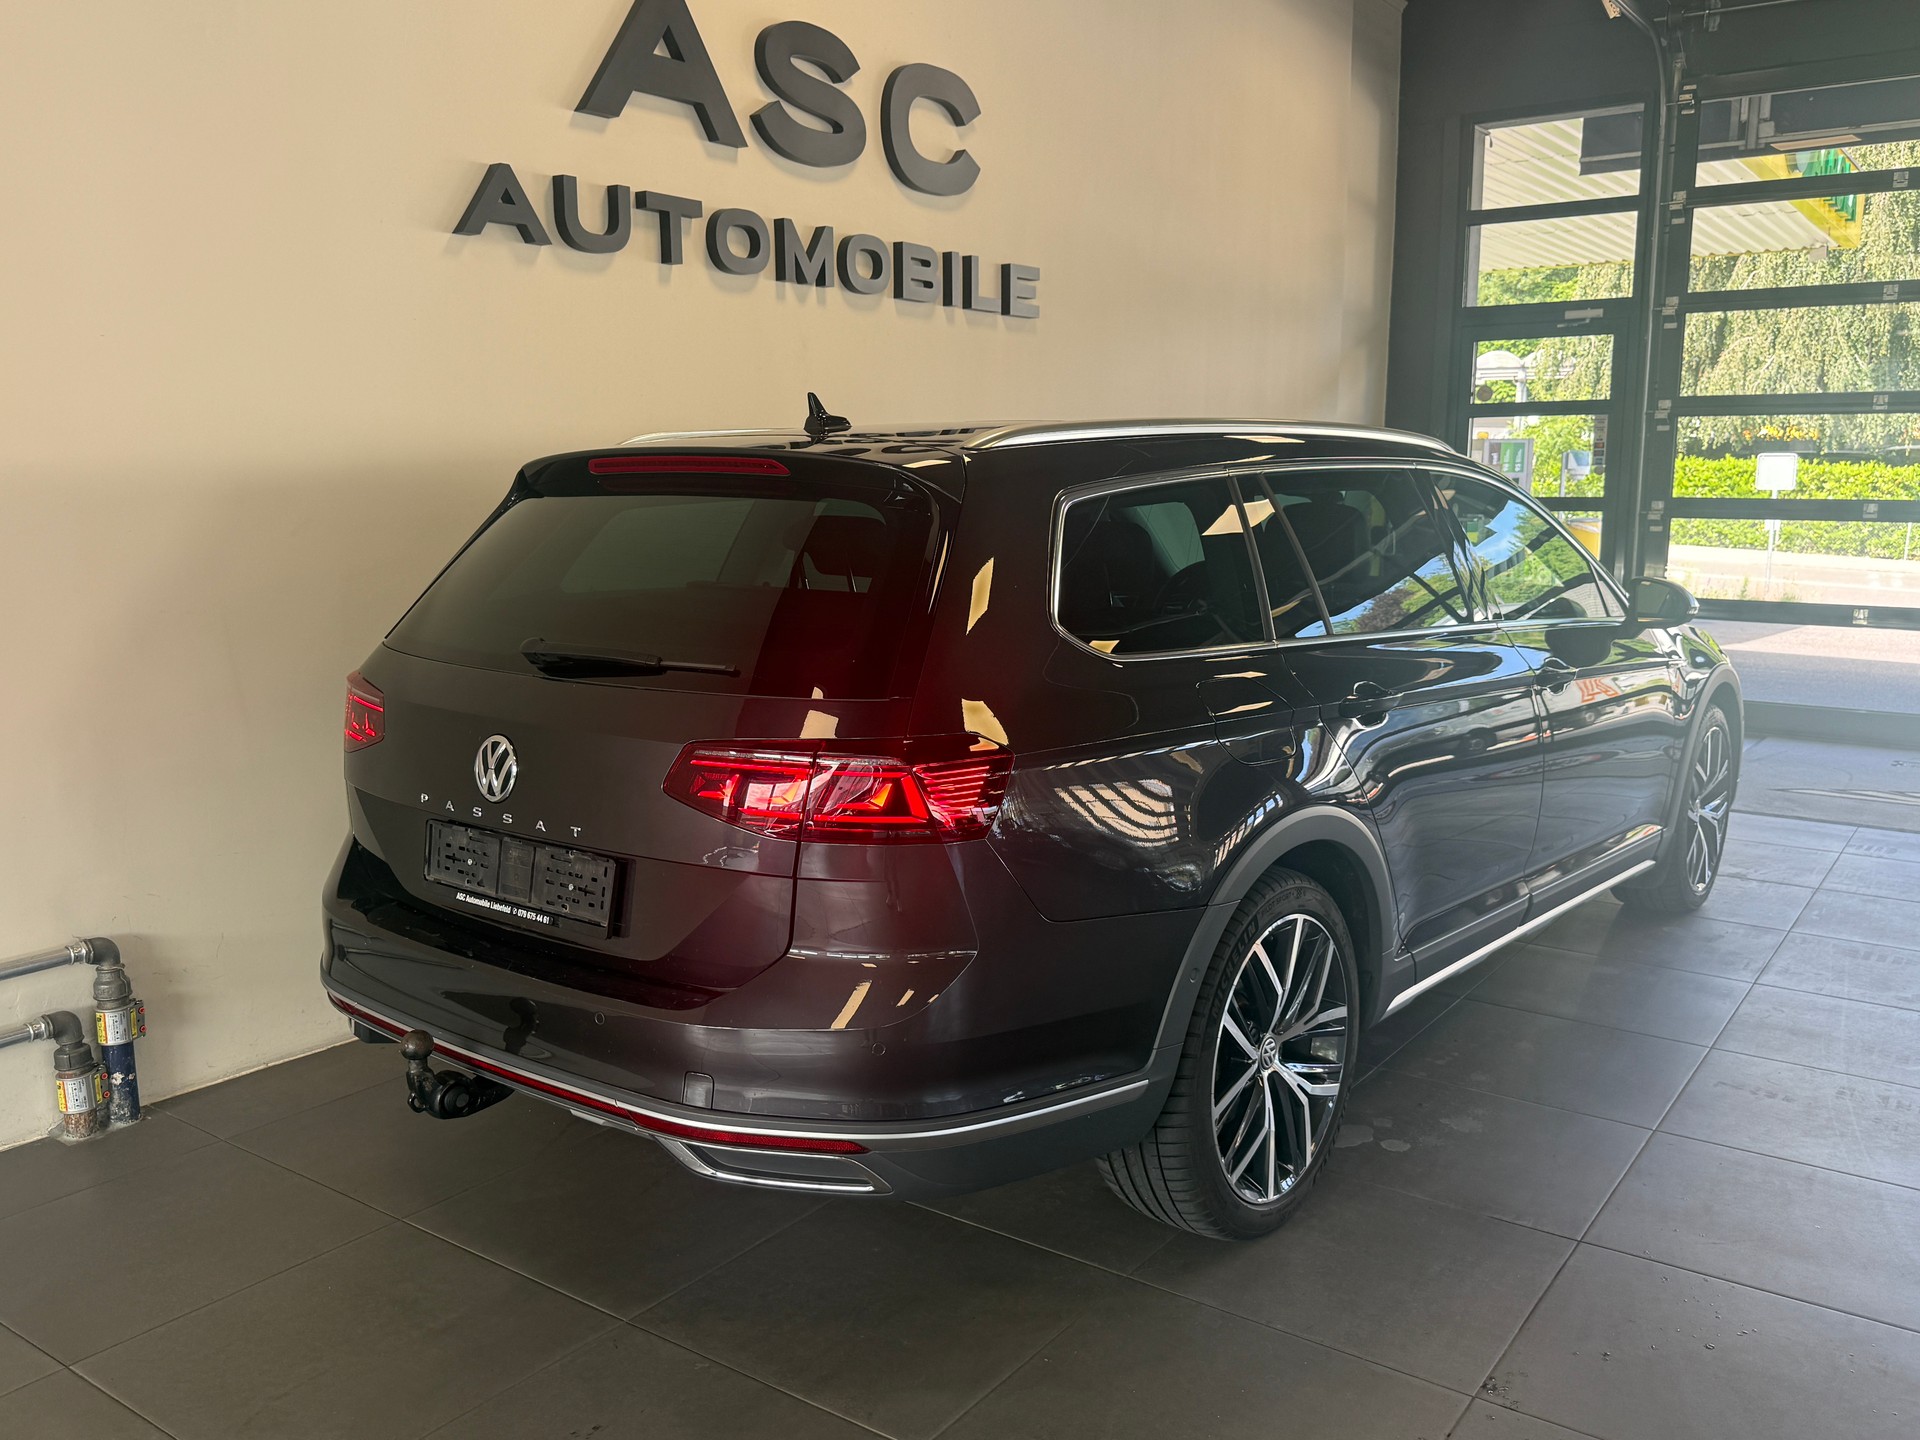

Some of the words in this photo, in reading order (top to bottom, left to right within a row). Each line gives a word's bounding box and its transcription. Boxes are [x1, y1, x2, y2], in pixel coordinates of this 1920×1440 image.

[574, 0, 982, 197] ASC
[452, 162, 1041, 319] AUTOMOBILE
[420, 793, 582, 838] PASSAT
[456, 892, 466, 902] ASC
[466, 894, 490, 908] Automobile
[490, 901, 511, 914] Liebefeld
